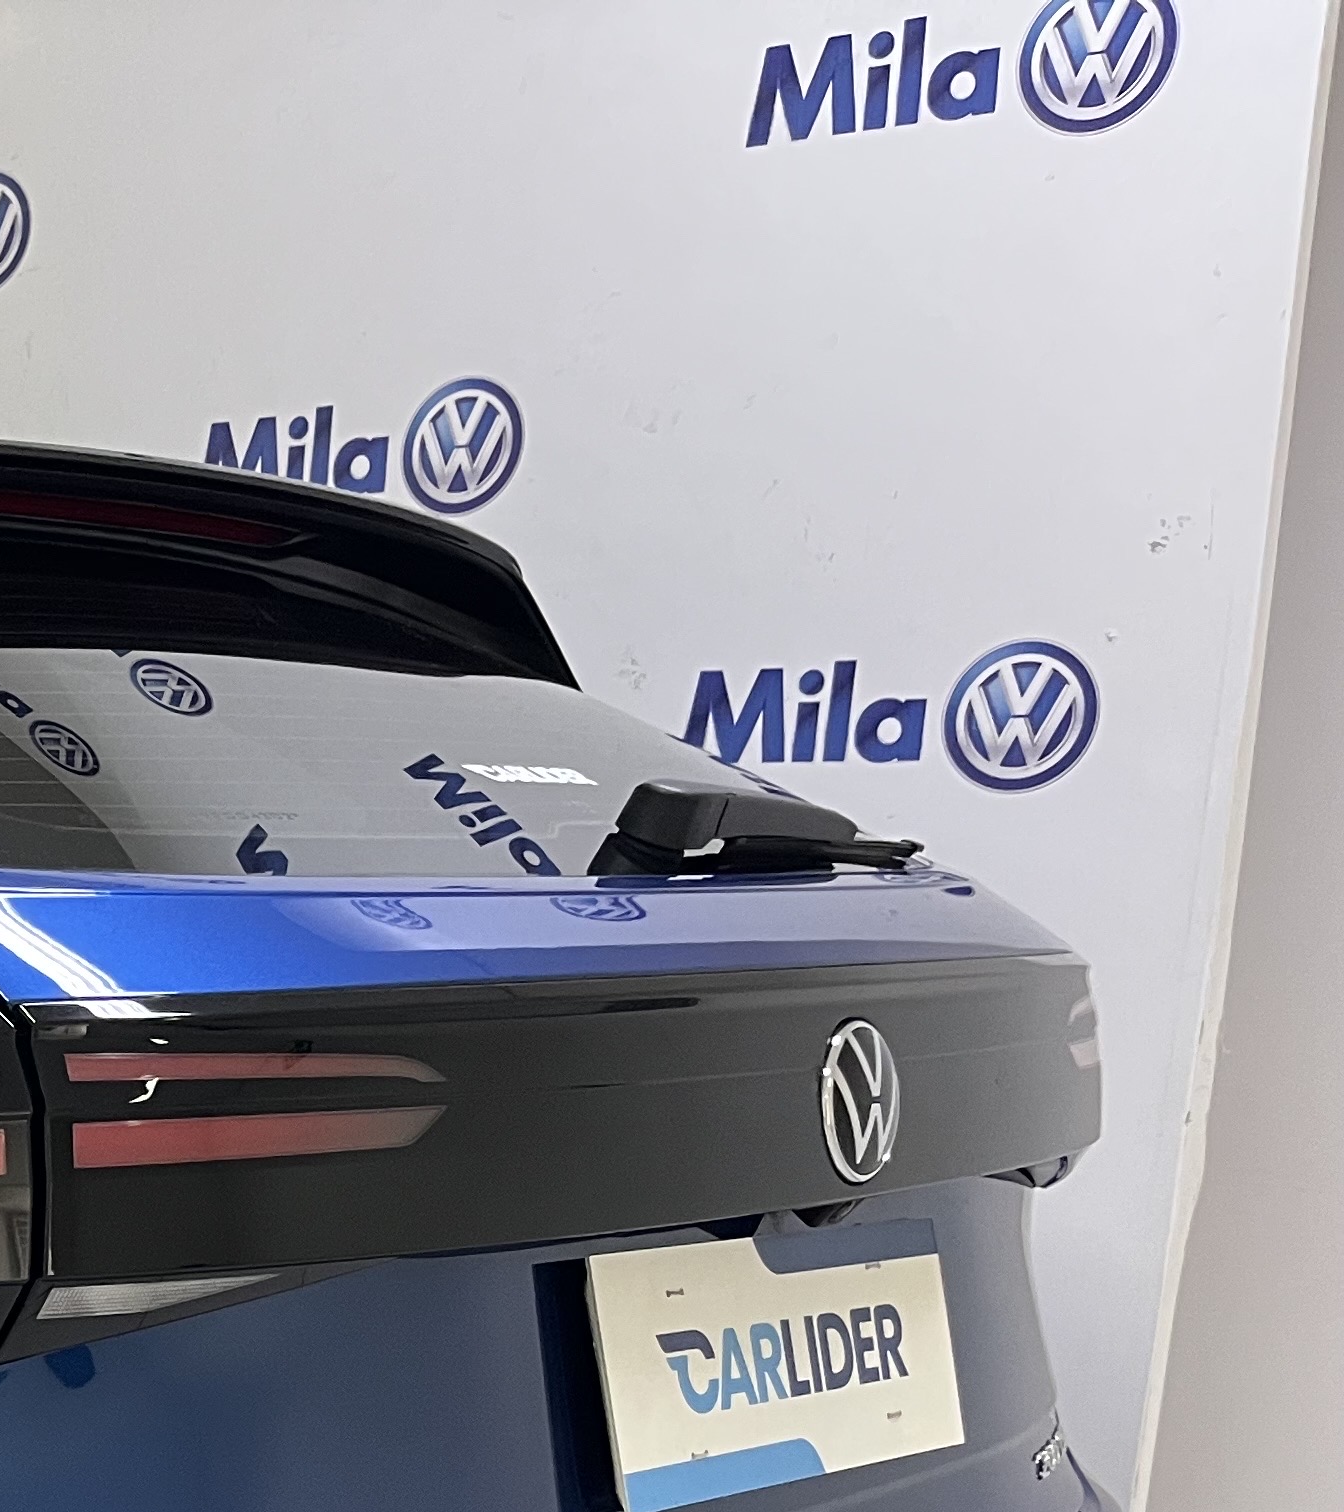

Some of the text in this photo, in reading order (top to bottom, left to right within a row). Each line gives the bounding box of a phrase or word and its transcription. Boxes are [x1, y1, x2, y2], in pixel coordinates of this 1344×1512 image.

[746, 16, 1000, 148] Mila
[205, 405, 389, 494] Mila
[682, 660, 927, 763] Mila
[656, 1303, 910, 1414] CARLIDER
